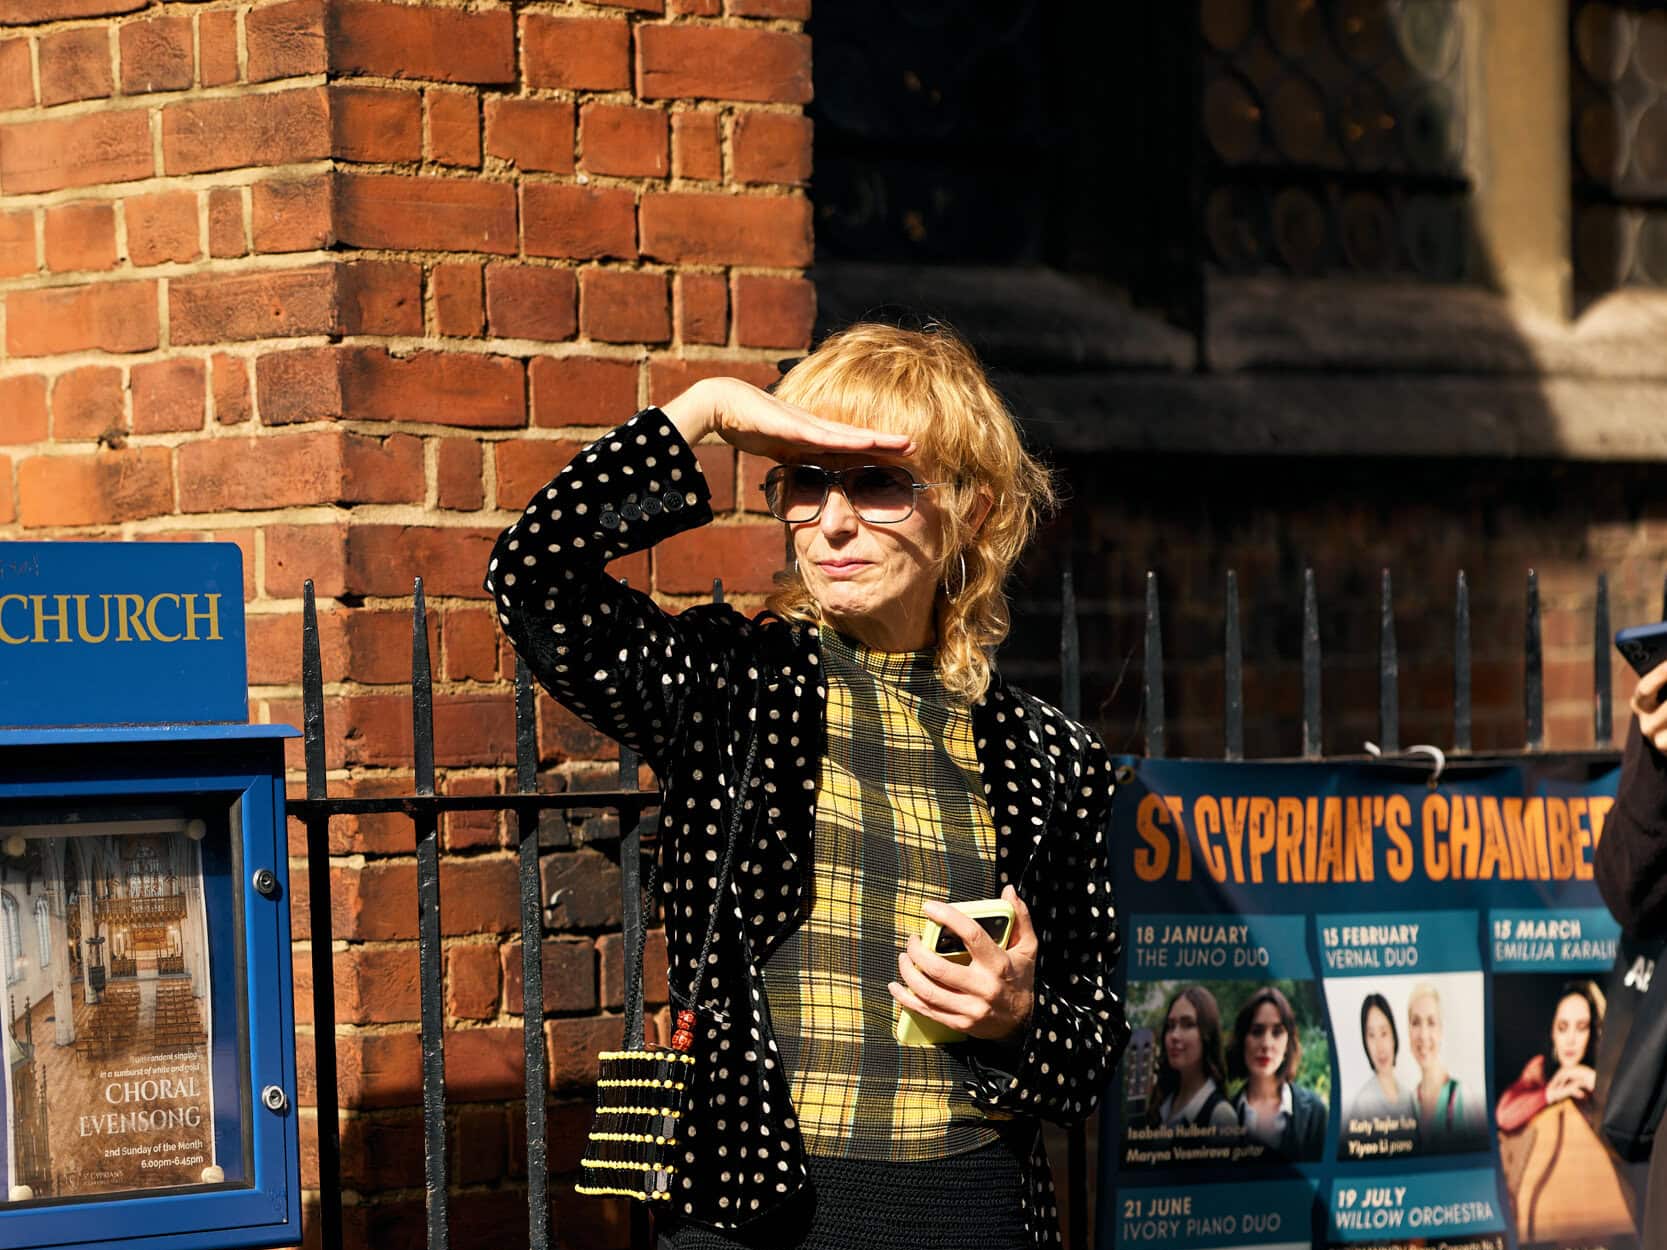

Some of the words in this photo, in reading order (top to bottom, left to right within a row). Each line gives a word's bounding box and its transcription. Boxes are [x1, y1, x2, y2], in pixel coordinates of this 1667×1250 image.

[0, 593, 223, 644] CHURCH
[1133, 792, 1192, 882] ST
[1193, 793, 1414, 884] CYPRIAN'S
[1136, 926, 1155, 945] 18
[1161, 925, 1249, 944] JANUARY
[1323, 927, 1339, 946] 15
[1342, 925, 1419, 946] FEBRUARY
[1515, 919, 1581, 940] MARCH
[1136, 948, 1168, 967] THE
[1175, 948, 1227, 967] JUNO
[1234, 947, 1269, 967] DUO
[1324, 949, 1381, 969] VERNAL
[1385, 947, 1418, 968] DUO
[1495, 942, 1555, 962] EMILIJA
[105, 1077, 200, 1104] CHORAL
[80, 1106, 200, 1136] EVENSONG
[104, 1146, 120, 1158] 2nd
[121, 1144, 151, 1156] Sunday
[153, 1143, 161, 1153] of
[163, 1142, 176, 1152] the
[178, 1139, 203, 1150] Month
[1123, 1199, 1142, 1218] 21
[1148, 1197, 1193, 1217] JUNE
[1337, 1189, 1357, 1208] 19
[1361, 1187, 1406, 1207] JULY
[1335, 1209, 1404, 1230] WILLOW
[1408, 1201, 1494, 1228] ORCHESTRA
[1123, 1220, 1180, 1241] IVORY
[1186, 1215, 1236, 1237] PIANO
[1243, 1213, 1281, 1233] DUO
